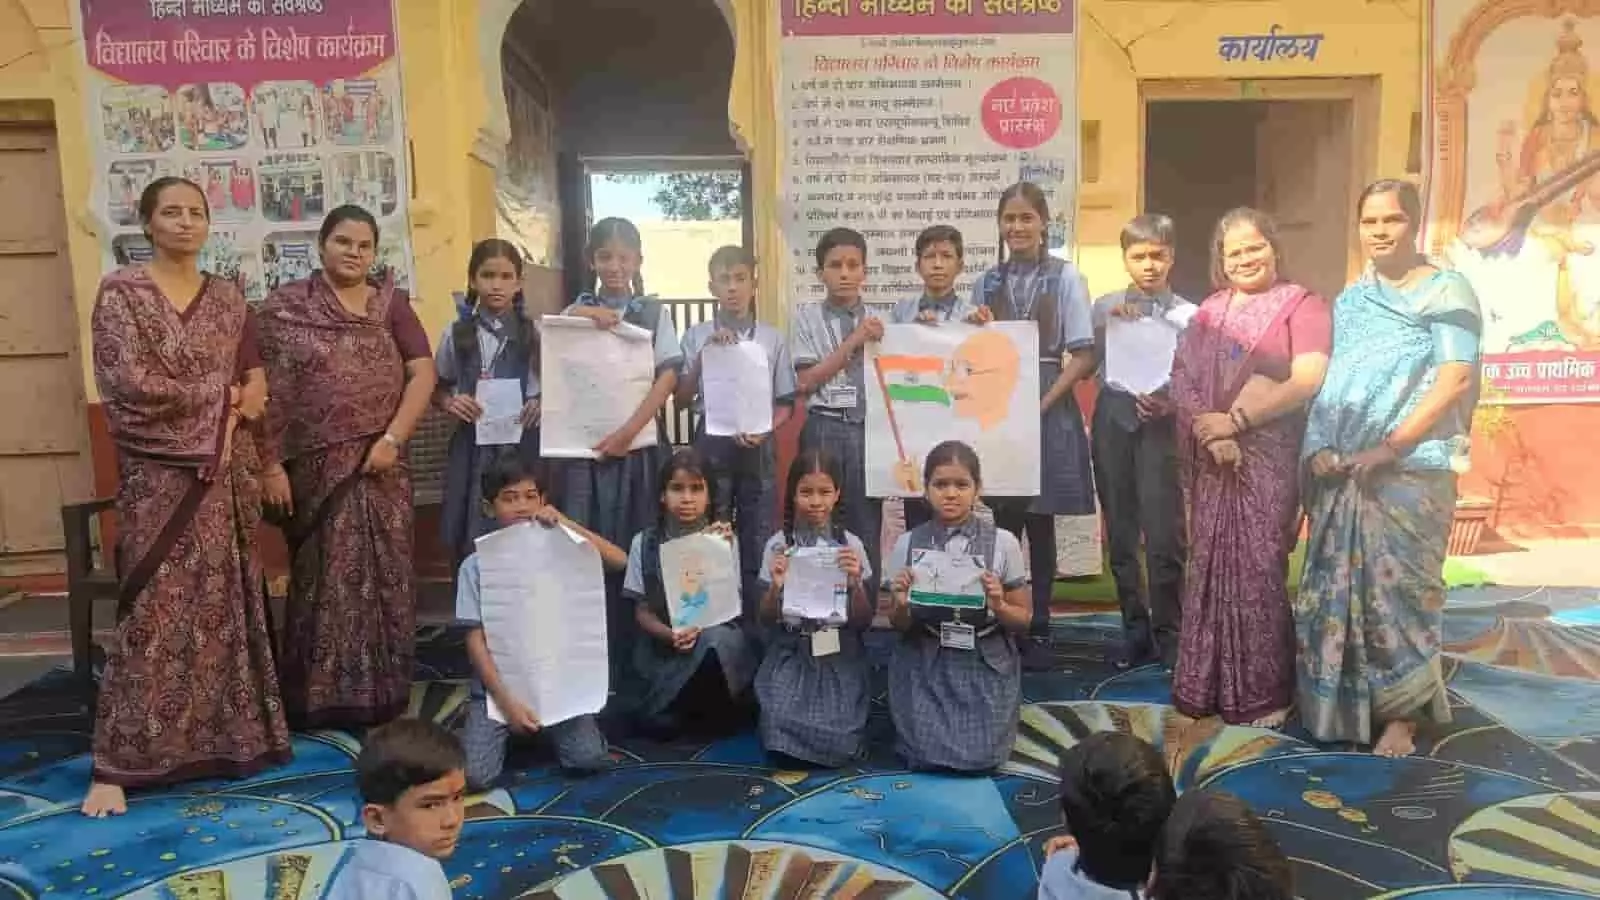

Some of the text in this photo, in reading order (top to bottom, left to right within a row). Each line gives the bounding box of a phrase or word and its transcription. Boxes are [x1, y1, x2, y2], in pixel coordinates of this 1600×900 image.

[95, 16, 387, 66] विद्यालय परिवार के विशेष कार्यक्रम
[1218, 24, 1324, 62] कार्यालय
[1535, 356, 1596, 379] प्राथमिक
